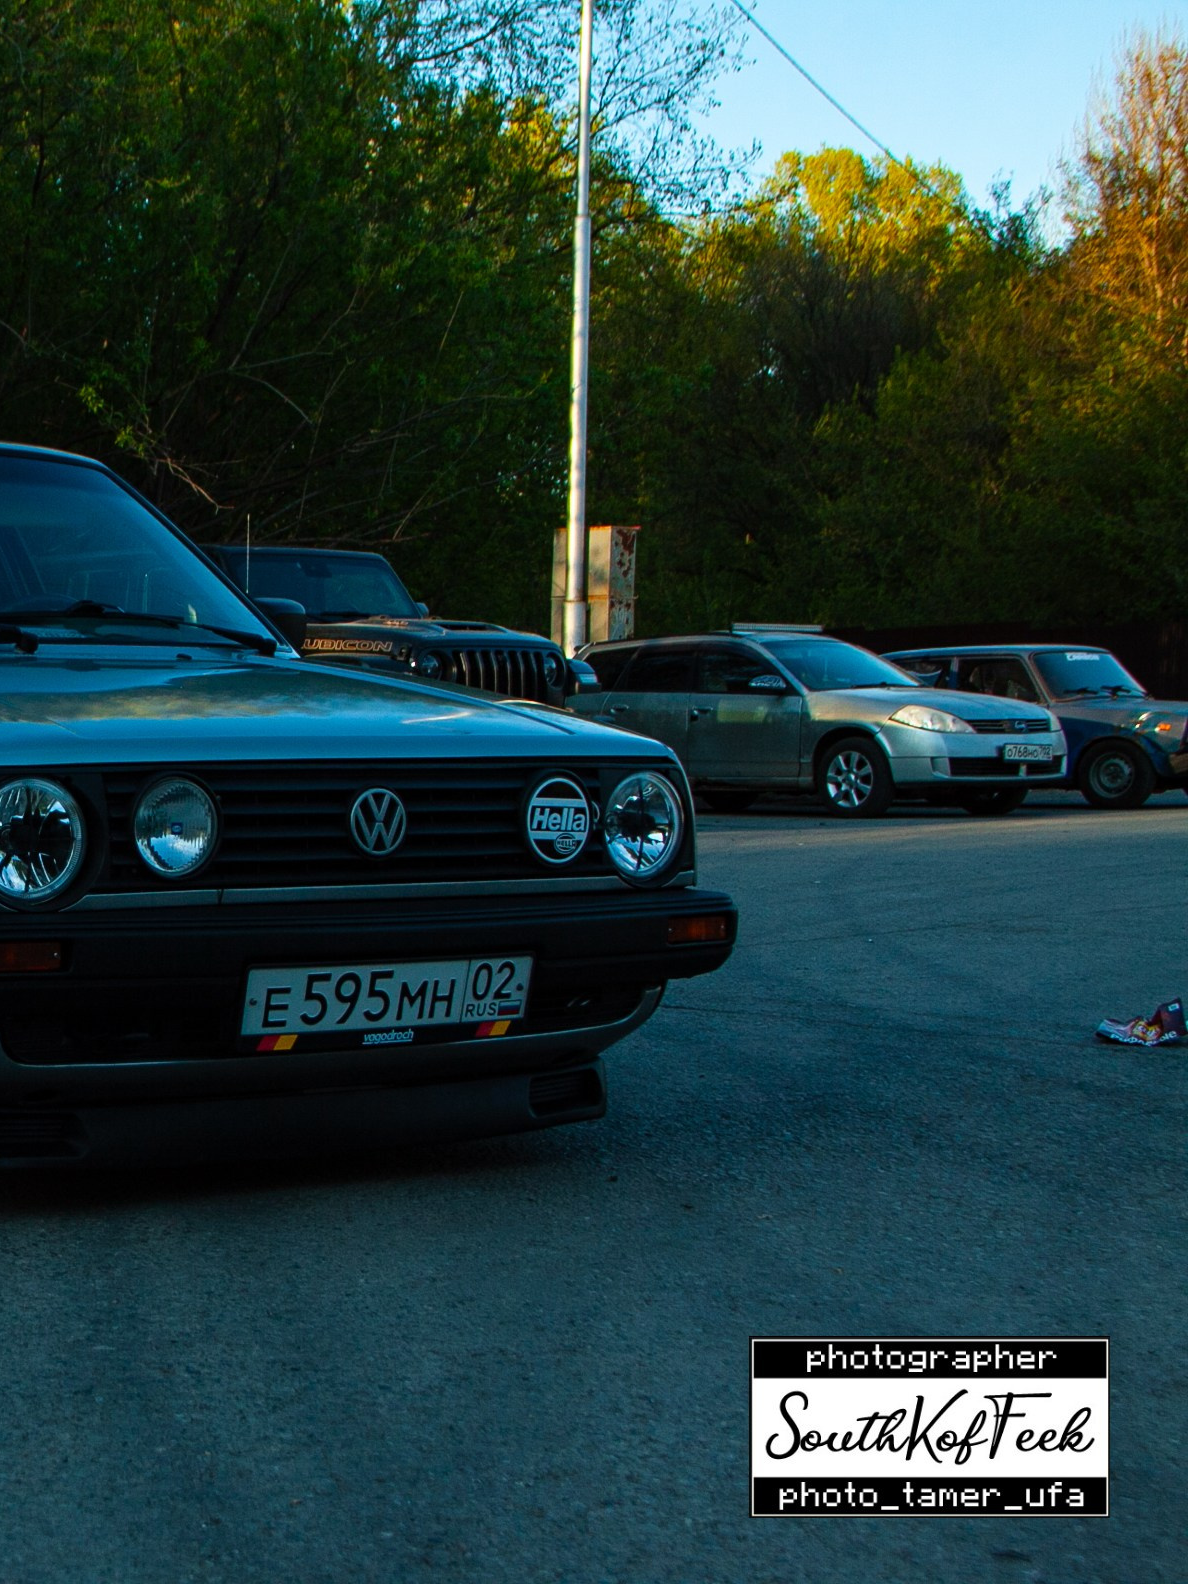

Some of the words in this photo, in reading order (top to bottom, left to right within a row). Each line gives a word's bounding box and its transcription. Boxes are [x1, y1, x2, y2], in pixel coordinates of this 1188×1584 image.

[301, 638, 393, 652] UBICON
[532, 807, 586, 832] Hella
[472, 960, 516, 1001] 02
[464, 1001, 497, 1018] RUS
